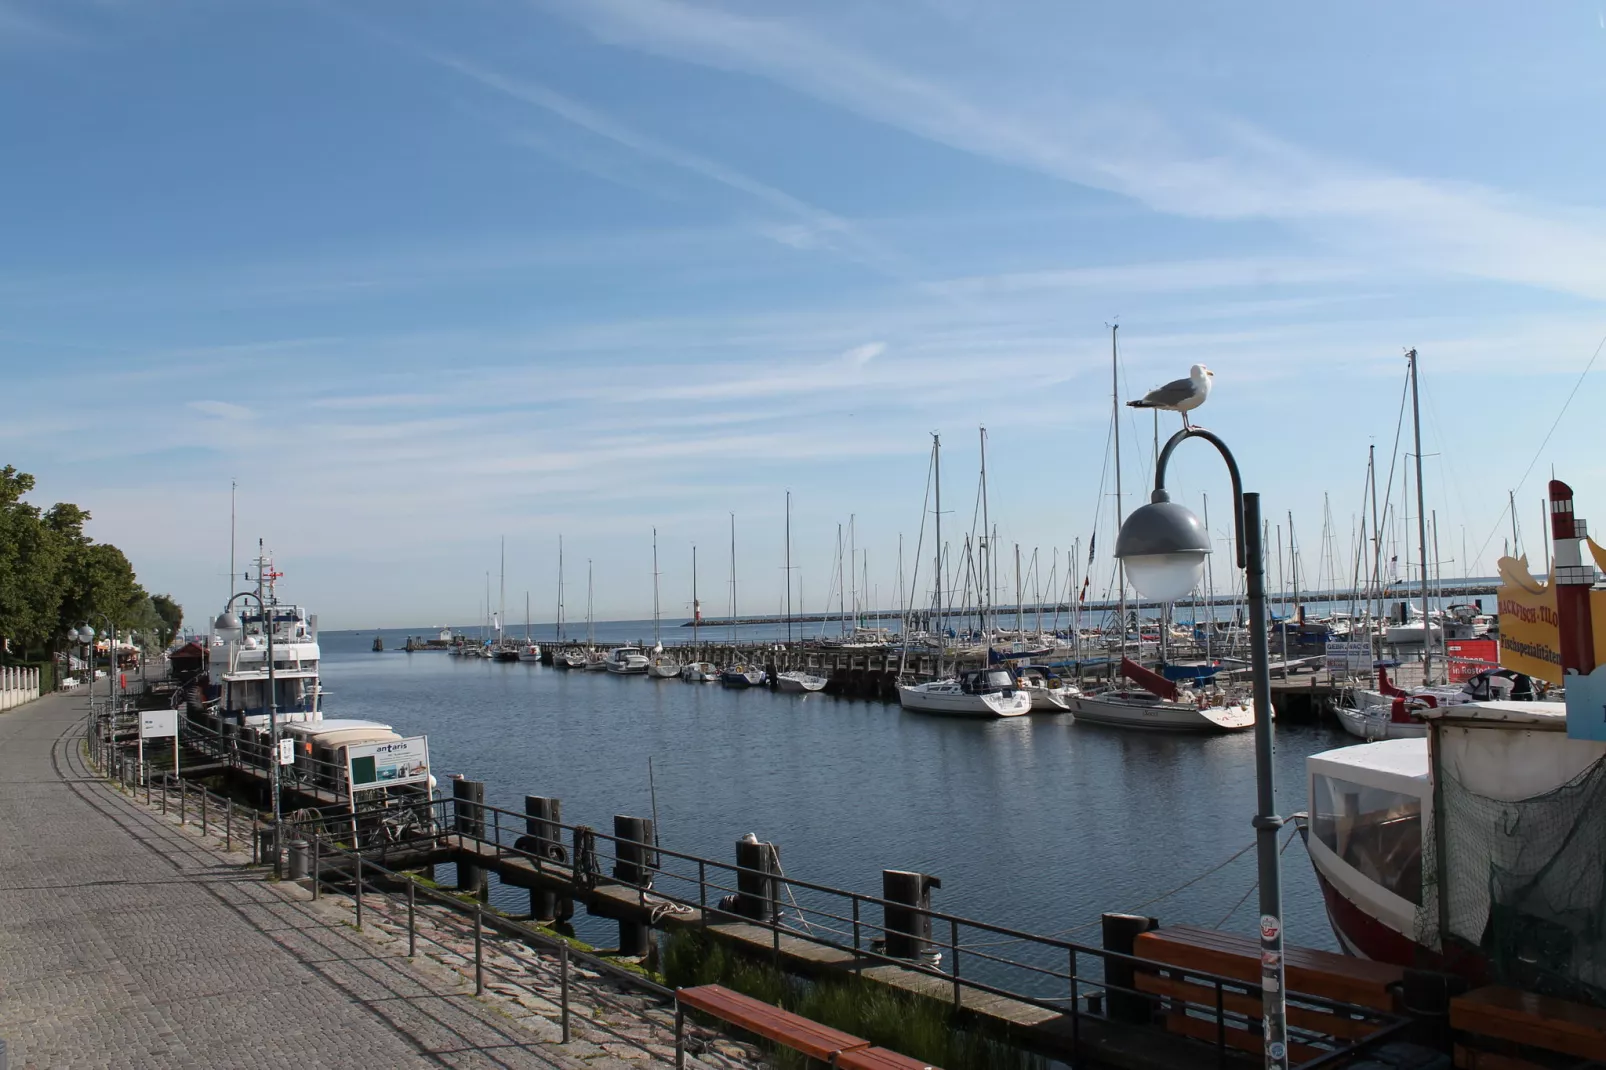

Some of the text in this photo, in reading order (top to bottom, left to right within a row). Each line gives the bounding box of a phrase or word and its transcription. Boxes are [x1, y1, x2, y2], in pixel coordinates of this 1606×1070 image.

[1540, 605, 1558, 627] TILO
[1500, 633, 1562, 665] Fischspezialitäten
[1452, 665, 1460, 674] in
[376, 742, 408, 753] antaris
